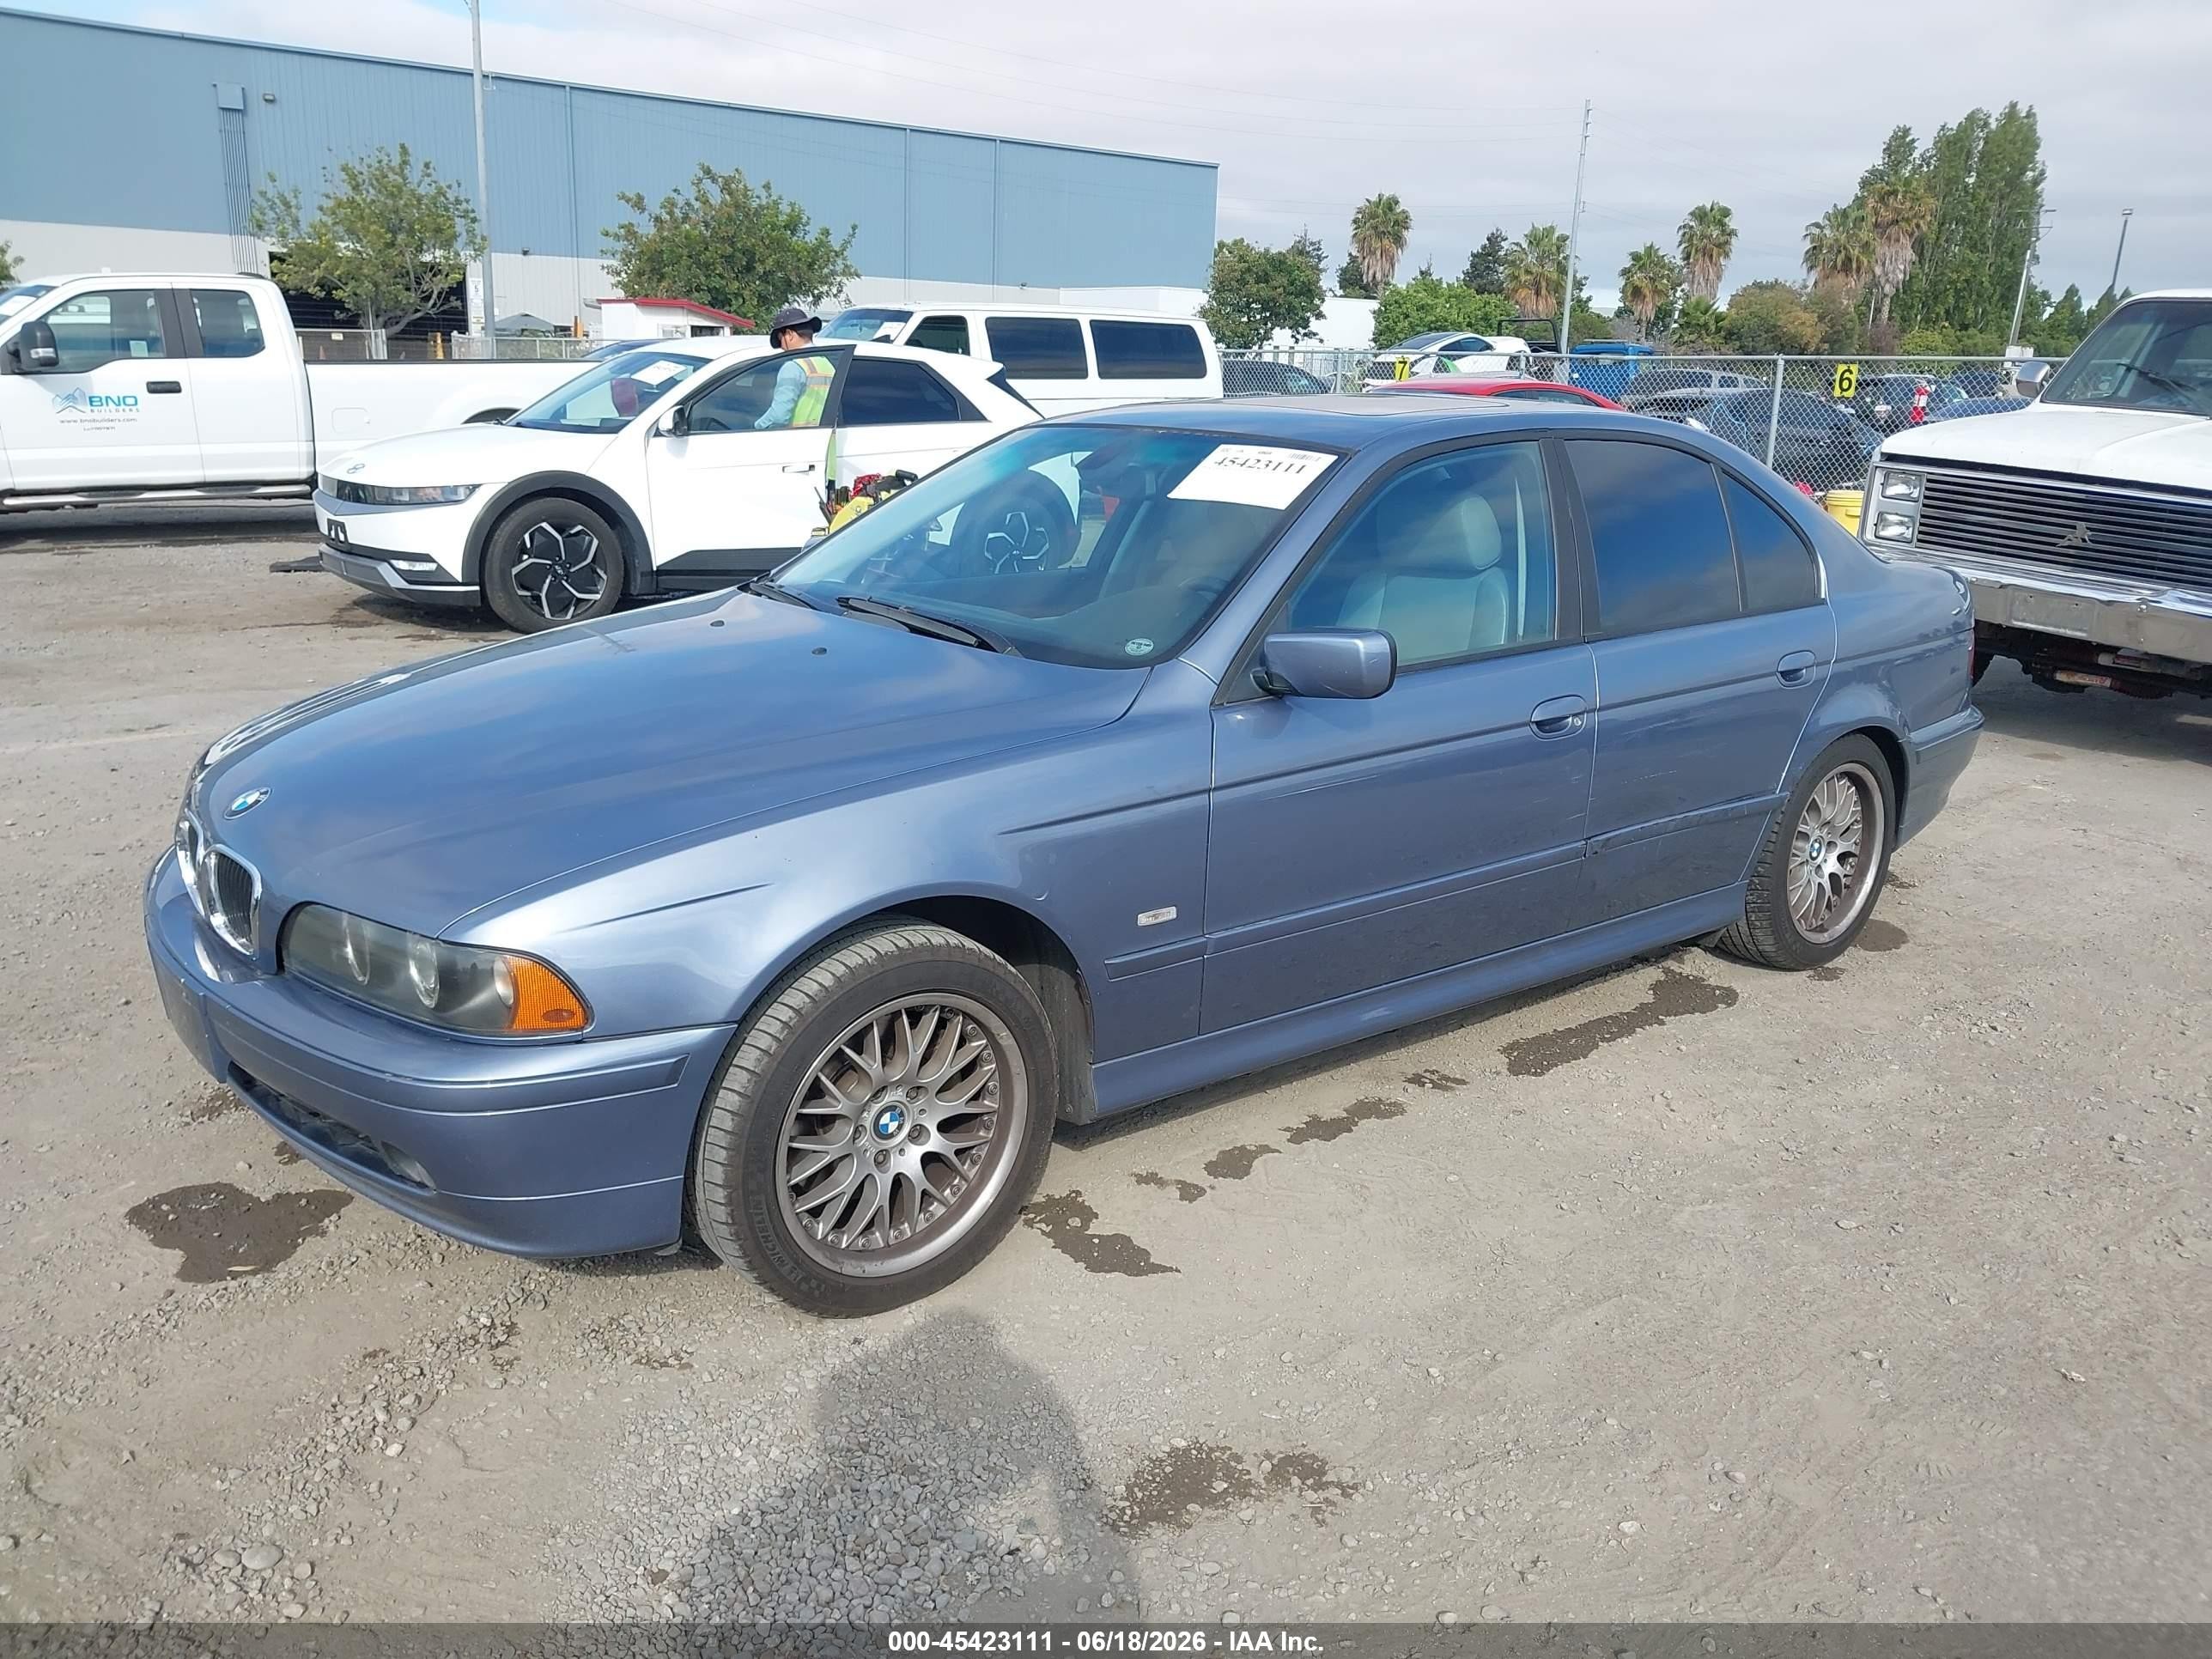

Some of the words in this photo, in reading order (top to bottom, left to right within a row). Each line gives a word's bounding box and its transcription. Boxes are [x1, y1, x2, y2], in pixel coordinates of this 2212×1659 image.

[1398, 360, 1407, 380] 7
[1838, 368, 1853, 392] 6
[88, 395, 138, 407] BNO
[1213, 457, 1306, 474] 45423111
[749, 1197, 804, 1282] MICHELIN
